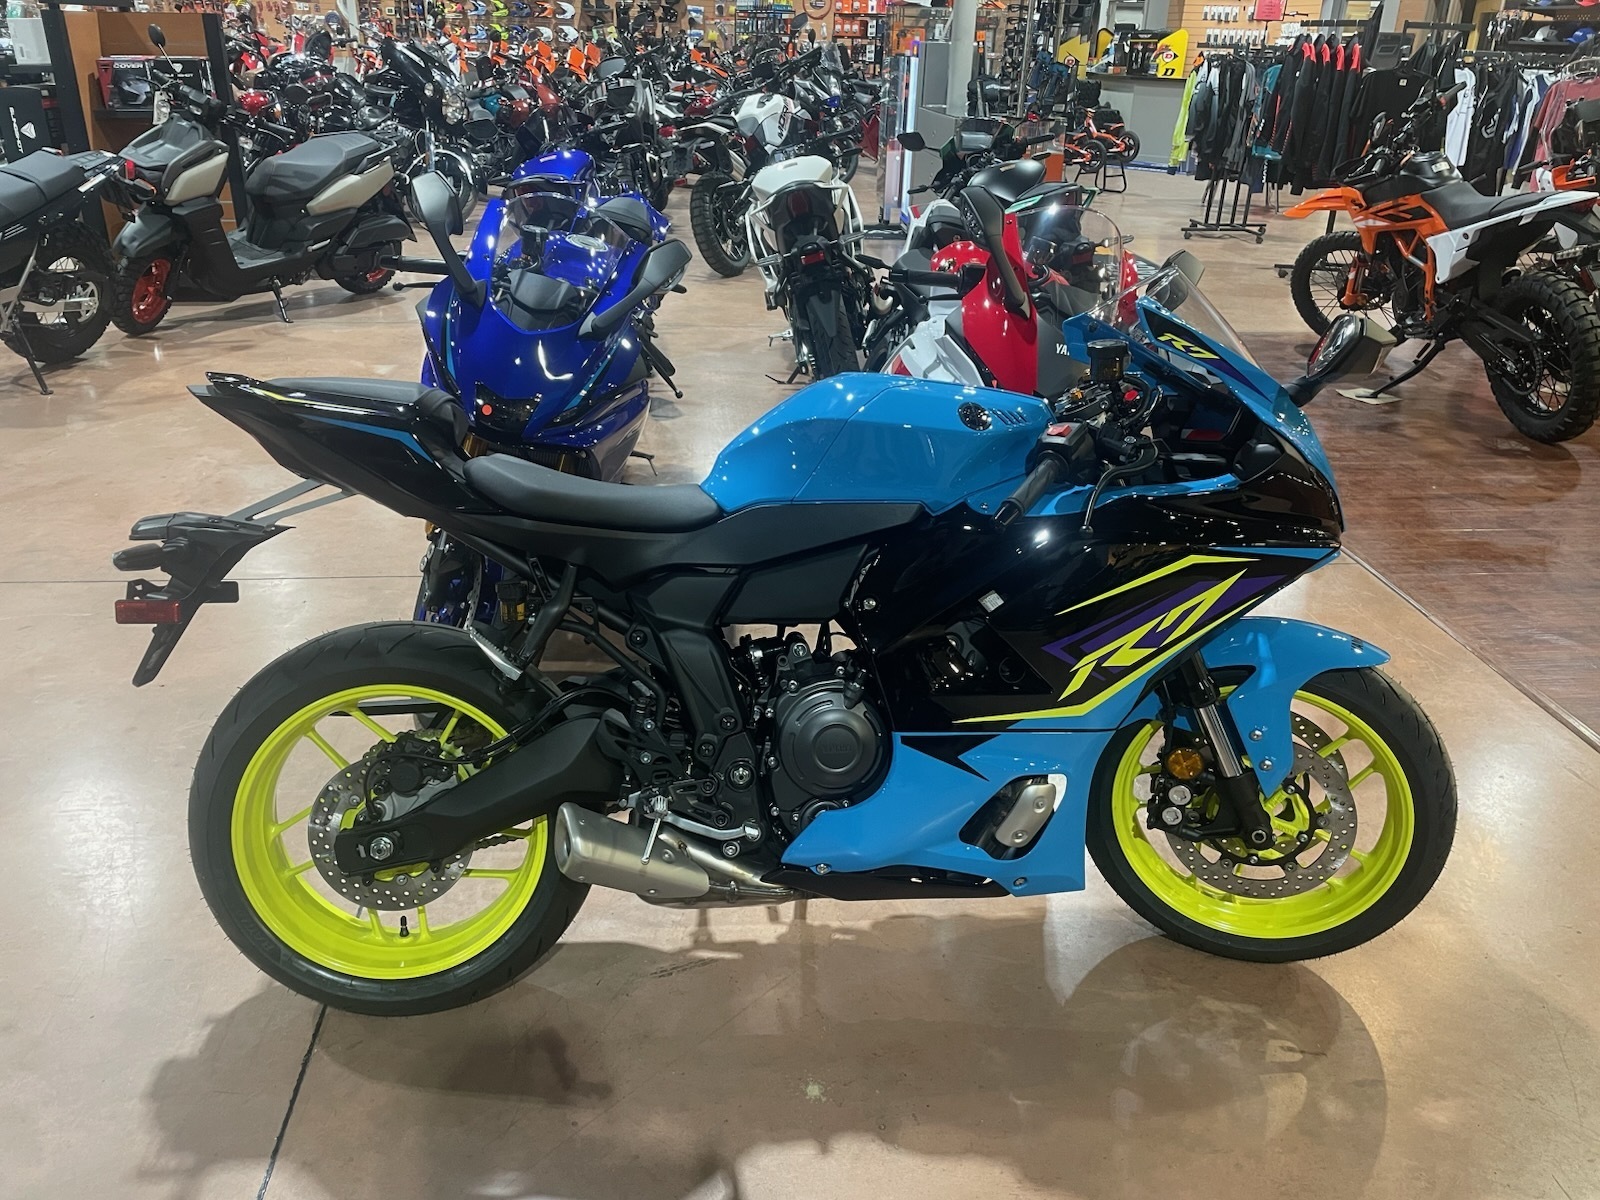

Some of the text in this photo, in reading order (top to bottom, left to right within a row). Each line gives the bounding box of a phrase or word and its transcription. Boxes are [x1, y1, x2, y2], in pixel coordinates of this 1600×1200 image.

[1055, 343, 1070, 356] YA
[1157, 332, 1221, 359] R7
[1057, 568, 1248, 702] R7
